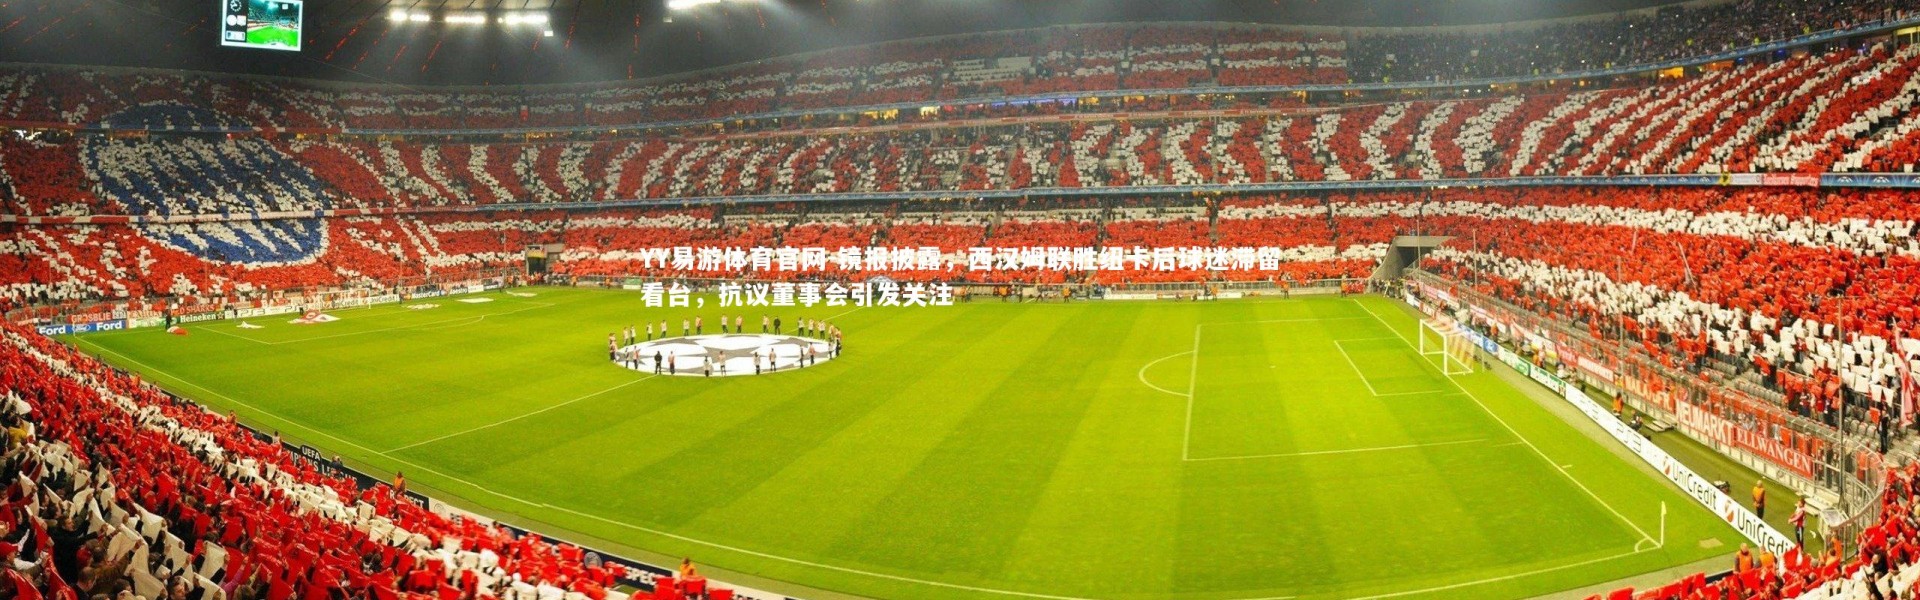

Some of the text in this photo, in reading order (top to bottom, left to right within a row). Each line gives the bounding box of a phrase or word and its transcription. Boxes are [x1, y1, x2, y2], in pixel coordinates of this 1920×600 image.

[38, 325, 66, 336] Ford
[96, 320, 122, 331] Ford
[180, 312, 217, 324] Heineken
[1677, 400, 1734, 446] NEUMARKT
[301, 446, 321, 461] UEFA
[1737, 427, 1812, 474] ELLWANGEN
[1672, 461, 1717, 510] UniCredit
